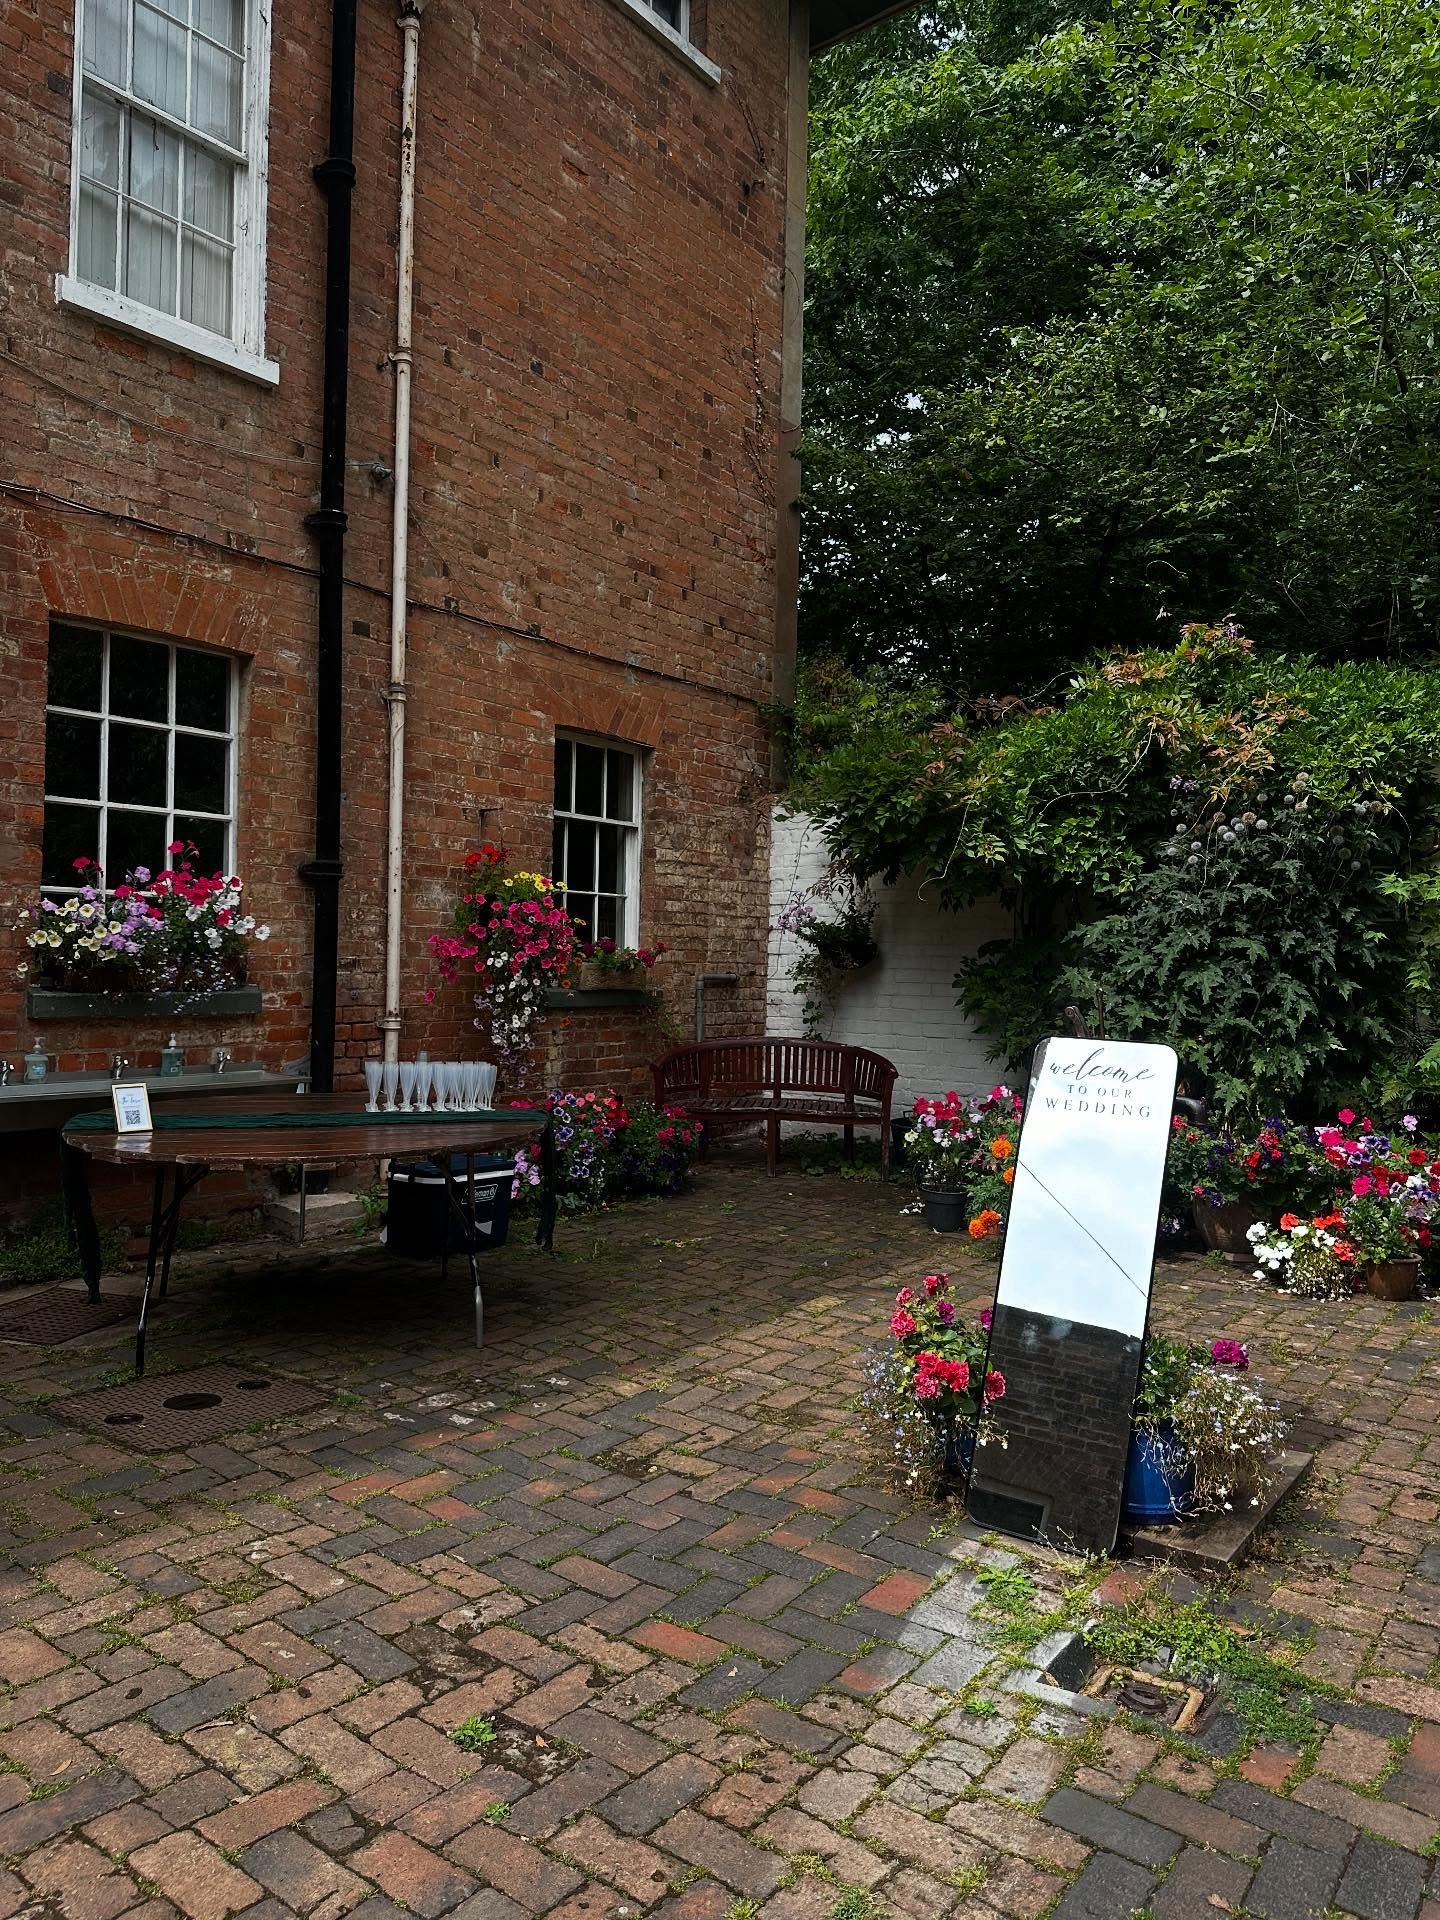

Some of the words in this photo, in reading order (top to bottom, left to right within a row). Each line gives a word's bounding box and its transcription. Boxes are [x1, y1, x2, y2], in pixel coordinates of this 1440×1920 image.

[1050, 1048, 1155, 1083] welcome
[1067, 1085, 1087, 1095] TO
[1097, 1087, 1132, 1099] OUR
[1046, 1097, 1150, 1118] WEDDING
